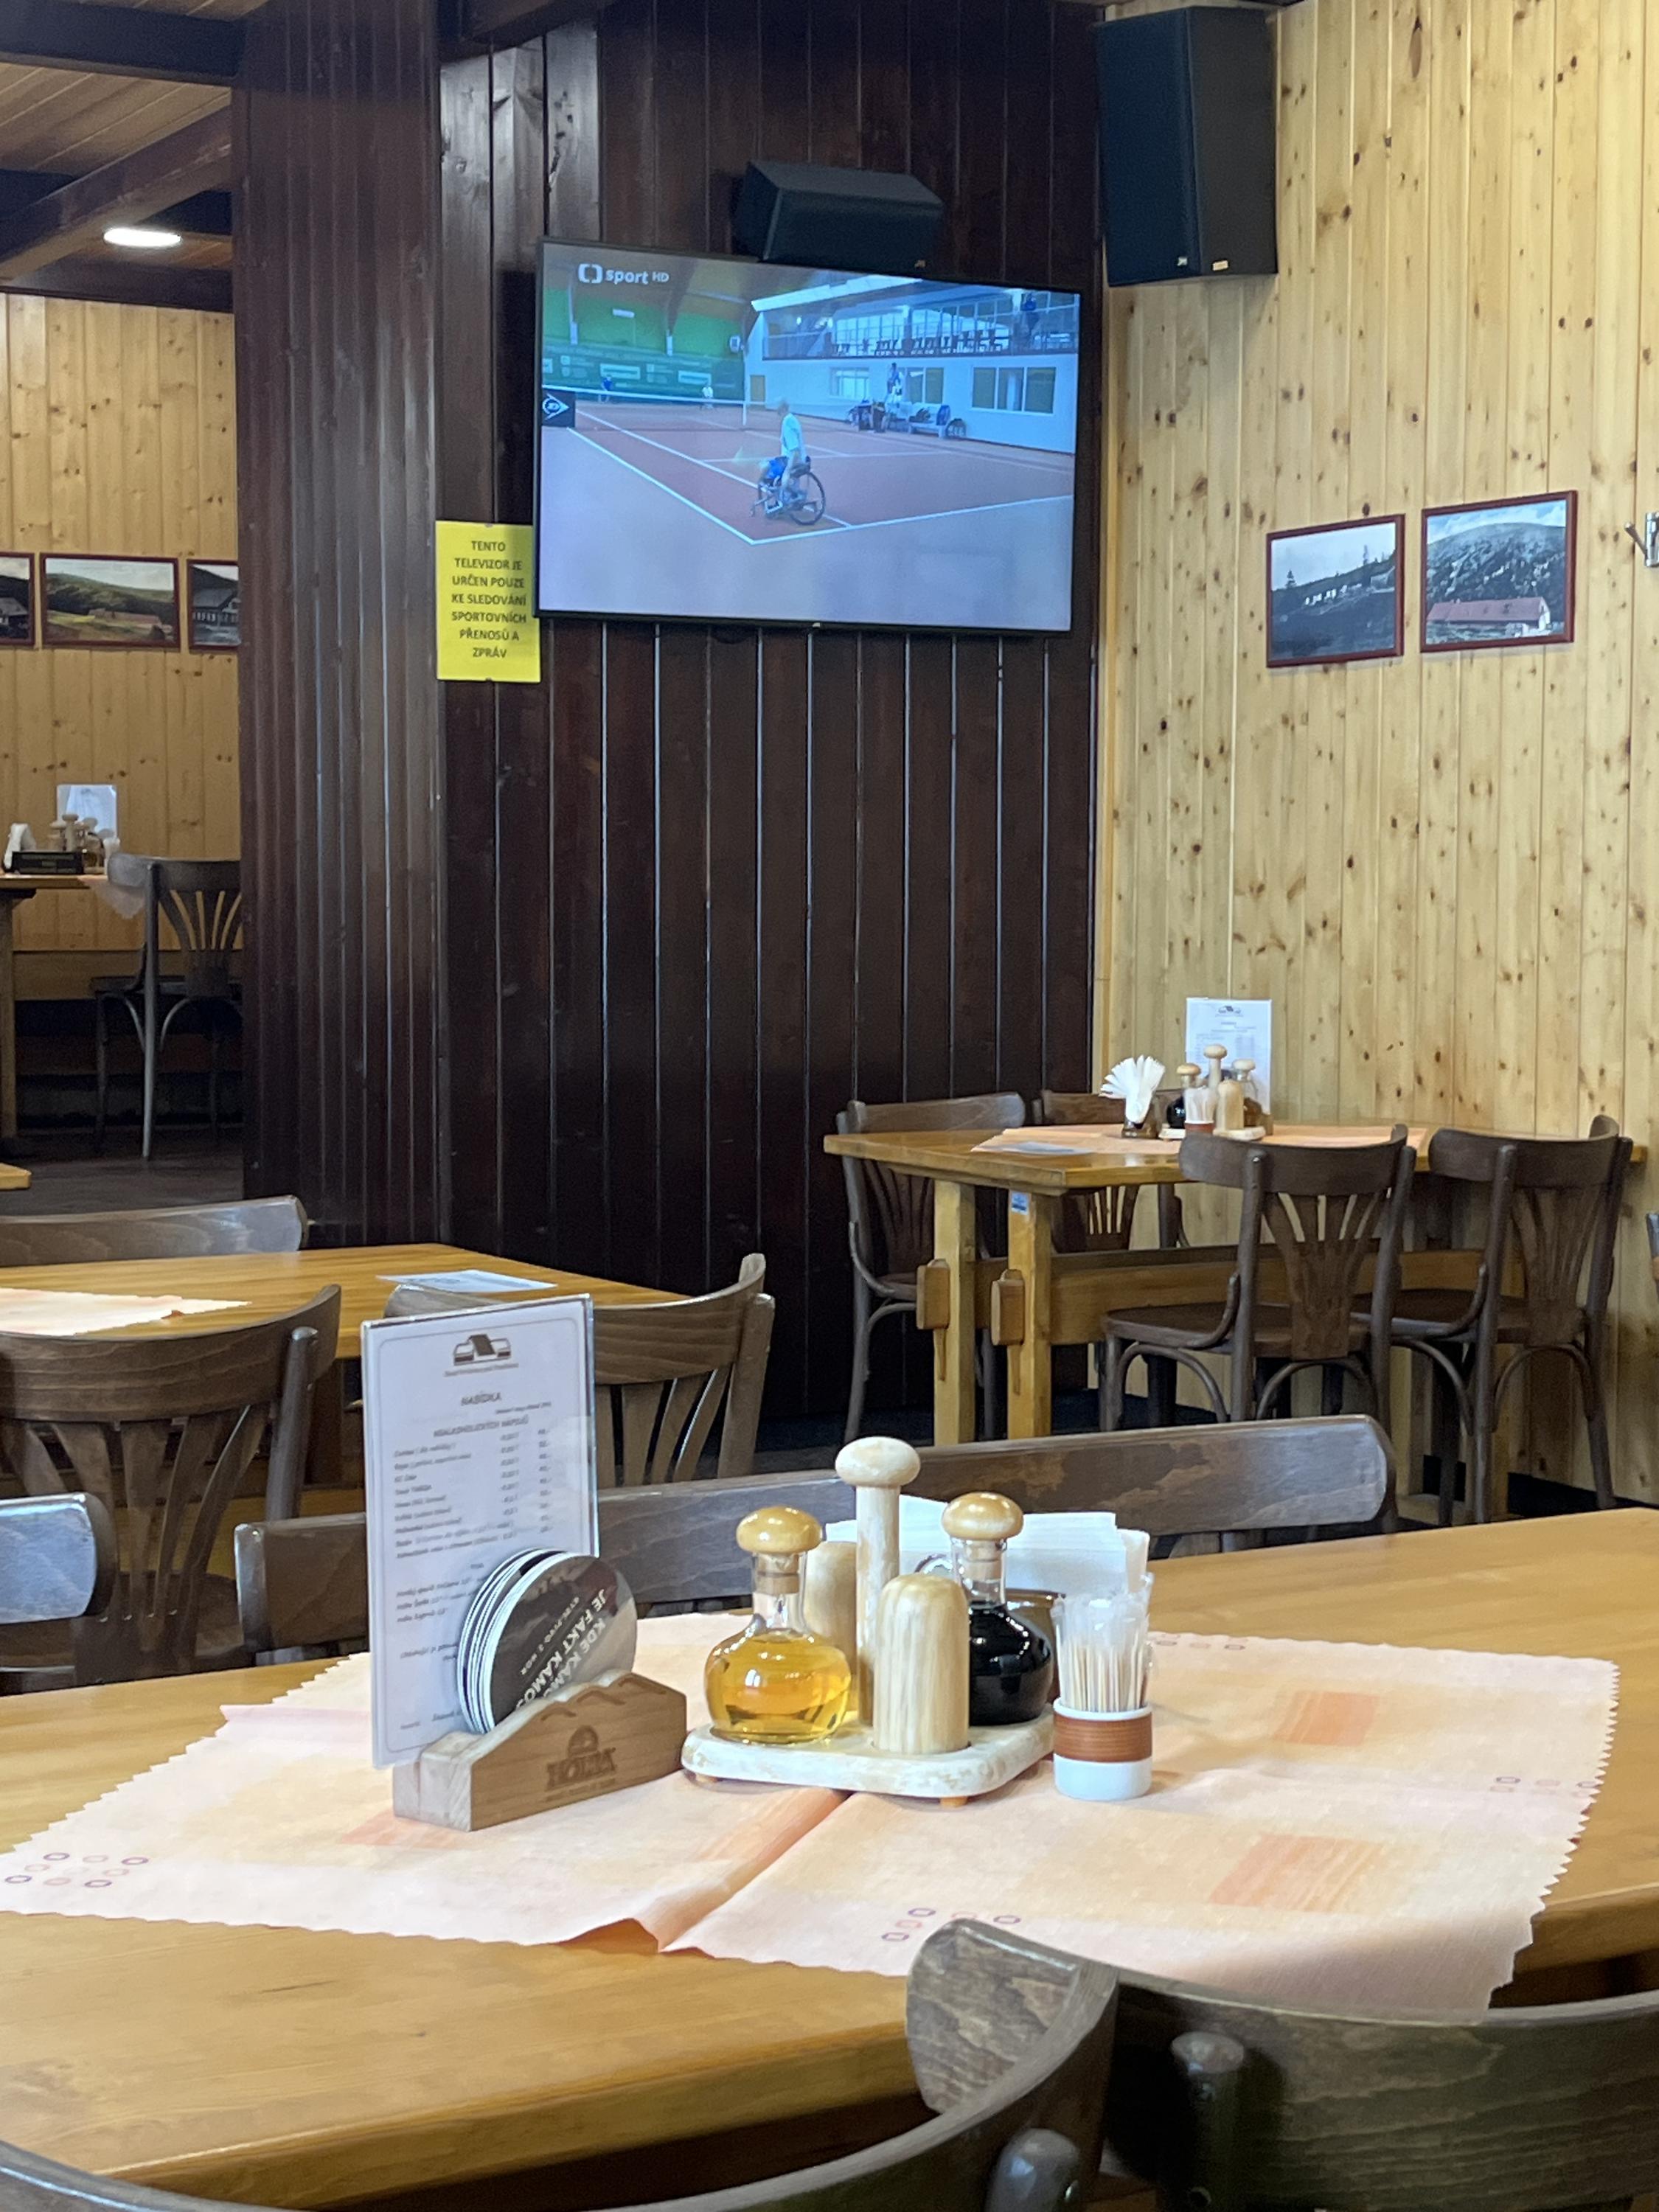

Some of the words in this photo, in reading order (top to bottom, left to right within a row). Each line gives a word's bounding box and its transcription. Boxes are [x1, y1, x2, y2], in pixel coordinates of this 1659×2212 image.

[606, 270, 649, 285] sport
[653, 271, 669, 282] HD
[471, 540, 506, 552] TENTO
[455, 557, 509, 569] TELEVIZOR
[512, 560, 523, 570] JE
[452, 574, 487, 586] URČEN
[491, 577, 524, 588] POUZE
[451, 594, 464, 603] KE
[467, 593, 526, 606] SLEDOVÁNÍ
[451, 611, 526, 623] SPORTOVNÍCH
[459, 627, 509, 641] PŘENOSŮ
[512, 632, 519, 641] A
[473, 646, 507, 658] ZPRÁV
[591, 1589, 606, 1612] JE
[563, 1609, 594, 1655] FAKT
[580, 1618, 606, 1654] KDE
